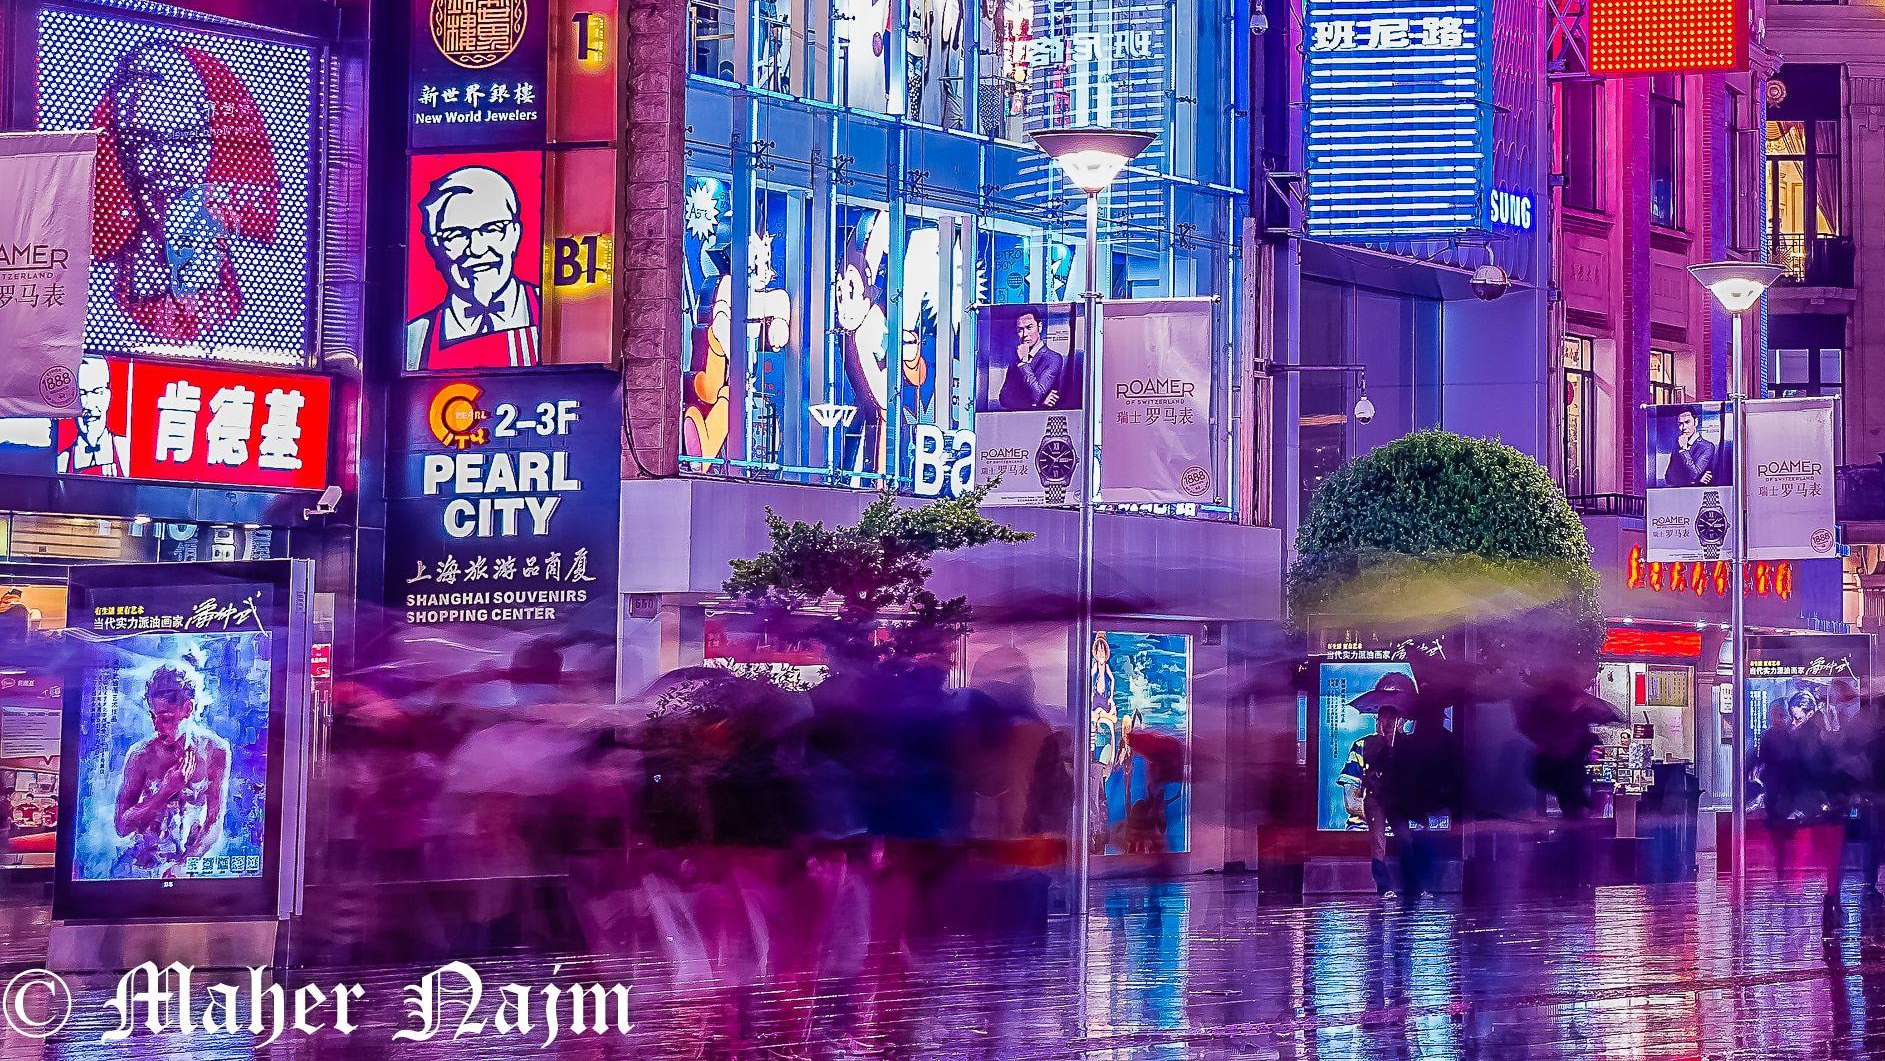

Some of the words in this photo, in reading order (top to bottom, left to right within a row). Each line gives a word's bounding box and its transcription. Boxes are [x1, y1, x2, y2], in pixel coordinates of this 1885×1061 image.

[571, 12, 592, 60] 1
[1312, 18, 1466, 51] 班尼路
[416, 111, 443, 124] New
[446, 110, 481, 124] World
[484, 109, 538, 122] Jewelers
[1490, 189, 1531, 229] SUNG
[554, 234, 602, 287] B1
[1116, 378, 1195, 398] ROAMER
[155, 380, 305, 470] 肯德基
[495, 400, 580, 438] 2-3F
[980, 448, 1029, 461] ROAMER
[1758, 460, 1822, 477] ROAMER
[423, 451, 581, 495] PEARL
[1184, 471, 1206, 485] 1888
[443, 497, 560, 538] CITY
[1652, 516, 1690, 526] ROAMER
[406, 546, 597, 584] 上海旅游品商厦
[406, 593, 490, 607] SHANGHAI
[493, 590, 587, 604] SOUVENIRS
[406, 610, 488, 624] SHOPPING
[492, 607, 556, 622] CENTER
